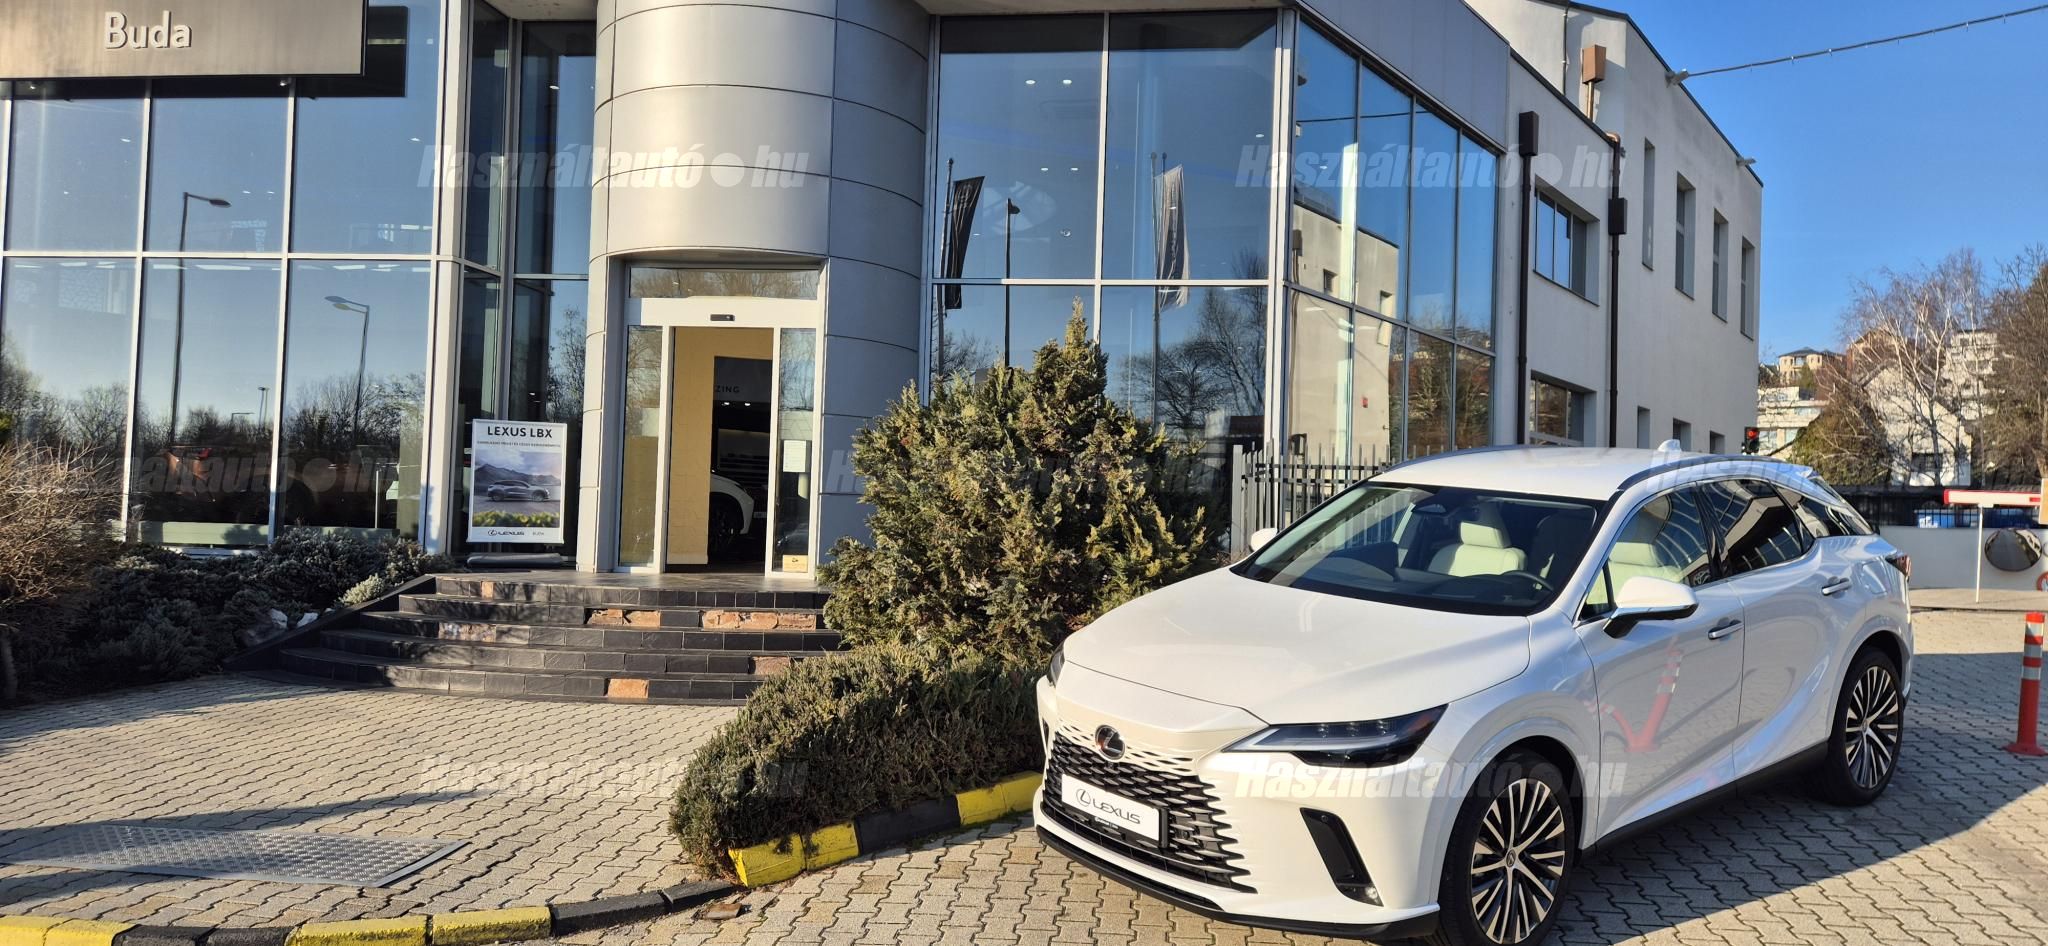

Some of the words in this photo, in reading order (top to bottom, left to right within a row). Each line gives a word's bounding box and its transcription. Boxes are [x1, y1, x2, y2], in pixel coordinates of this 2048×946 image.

[105, 10, 192, 49] Buda
[487, 426, 526, 437] LEXUS
[530, 428, 553, 438] LBX
[1092, 798, 1141, 825] LEXUS
